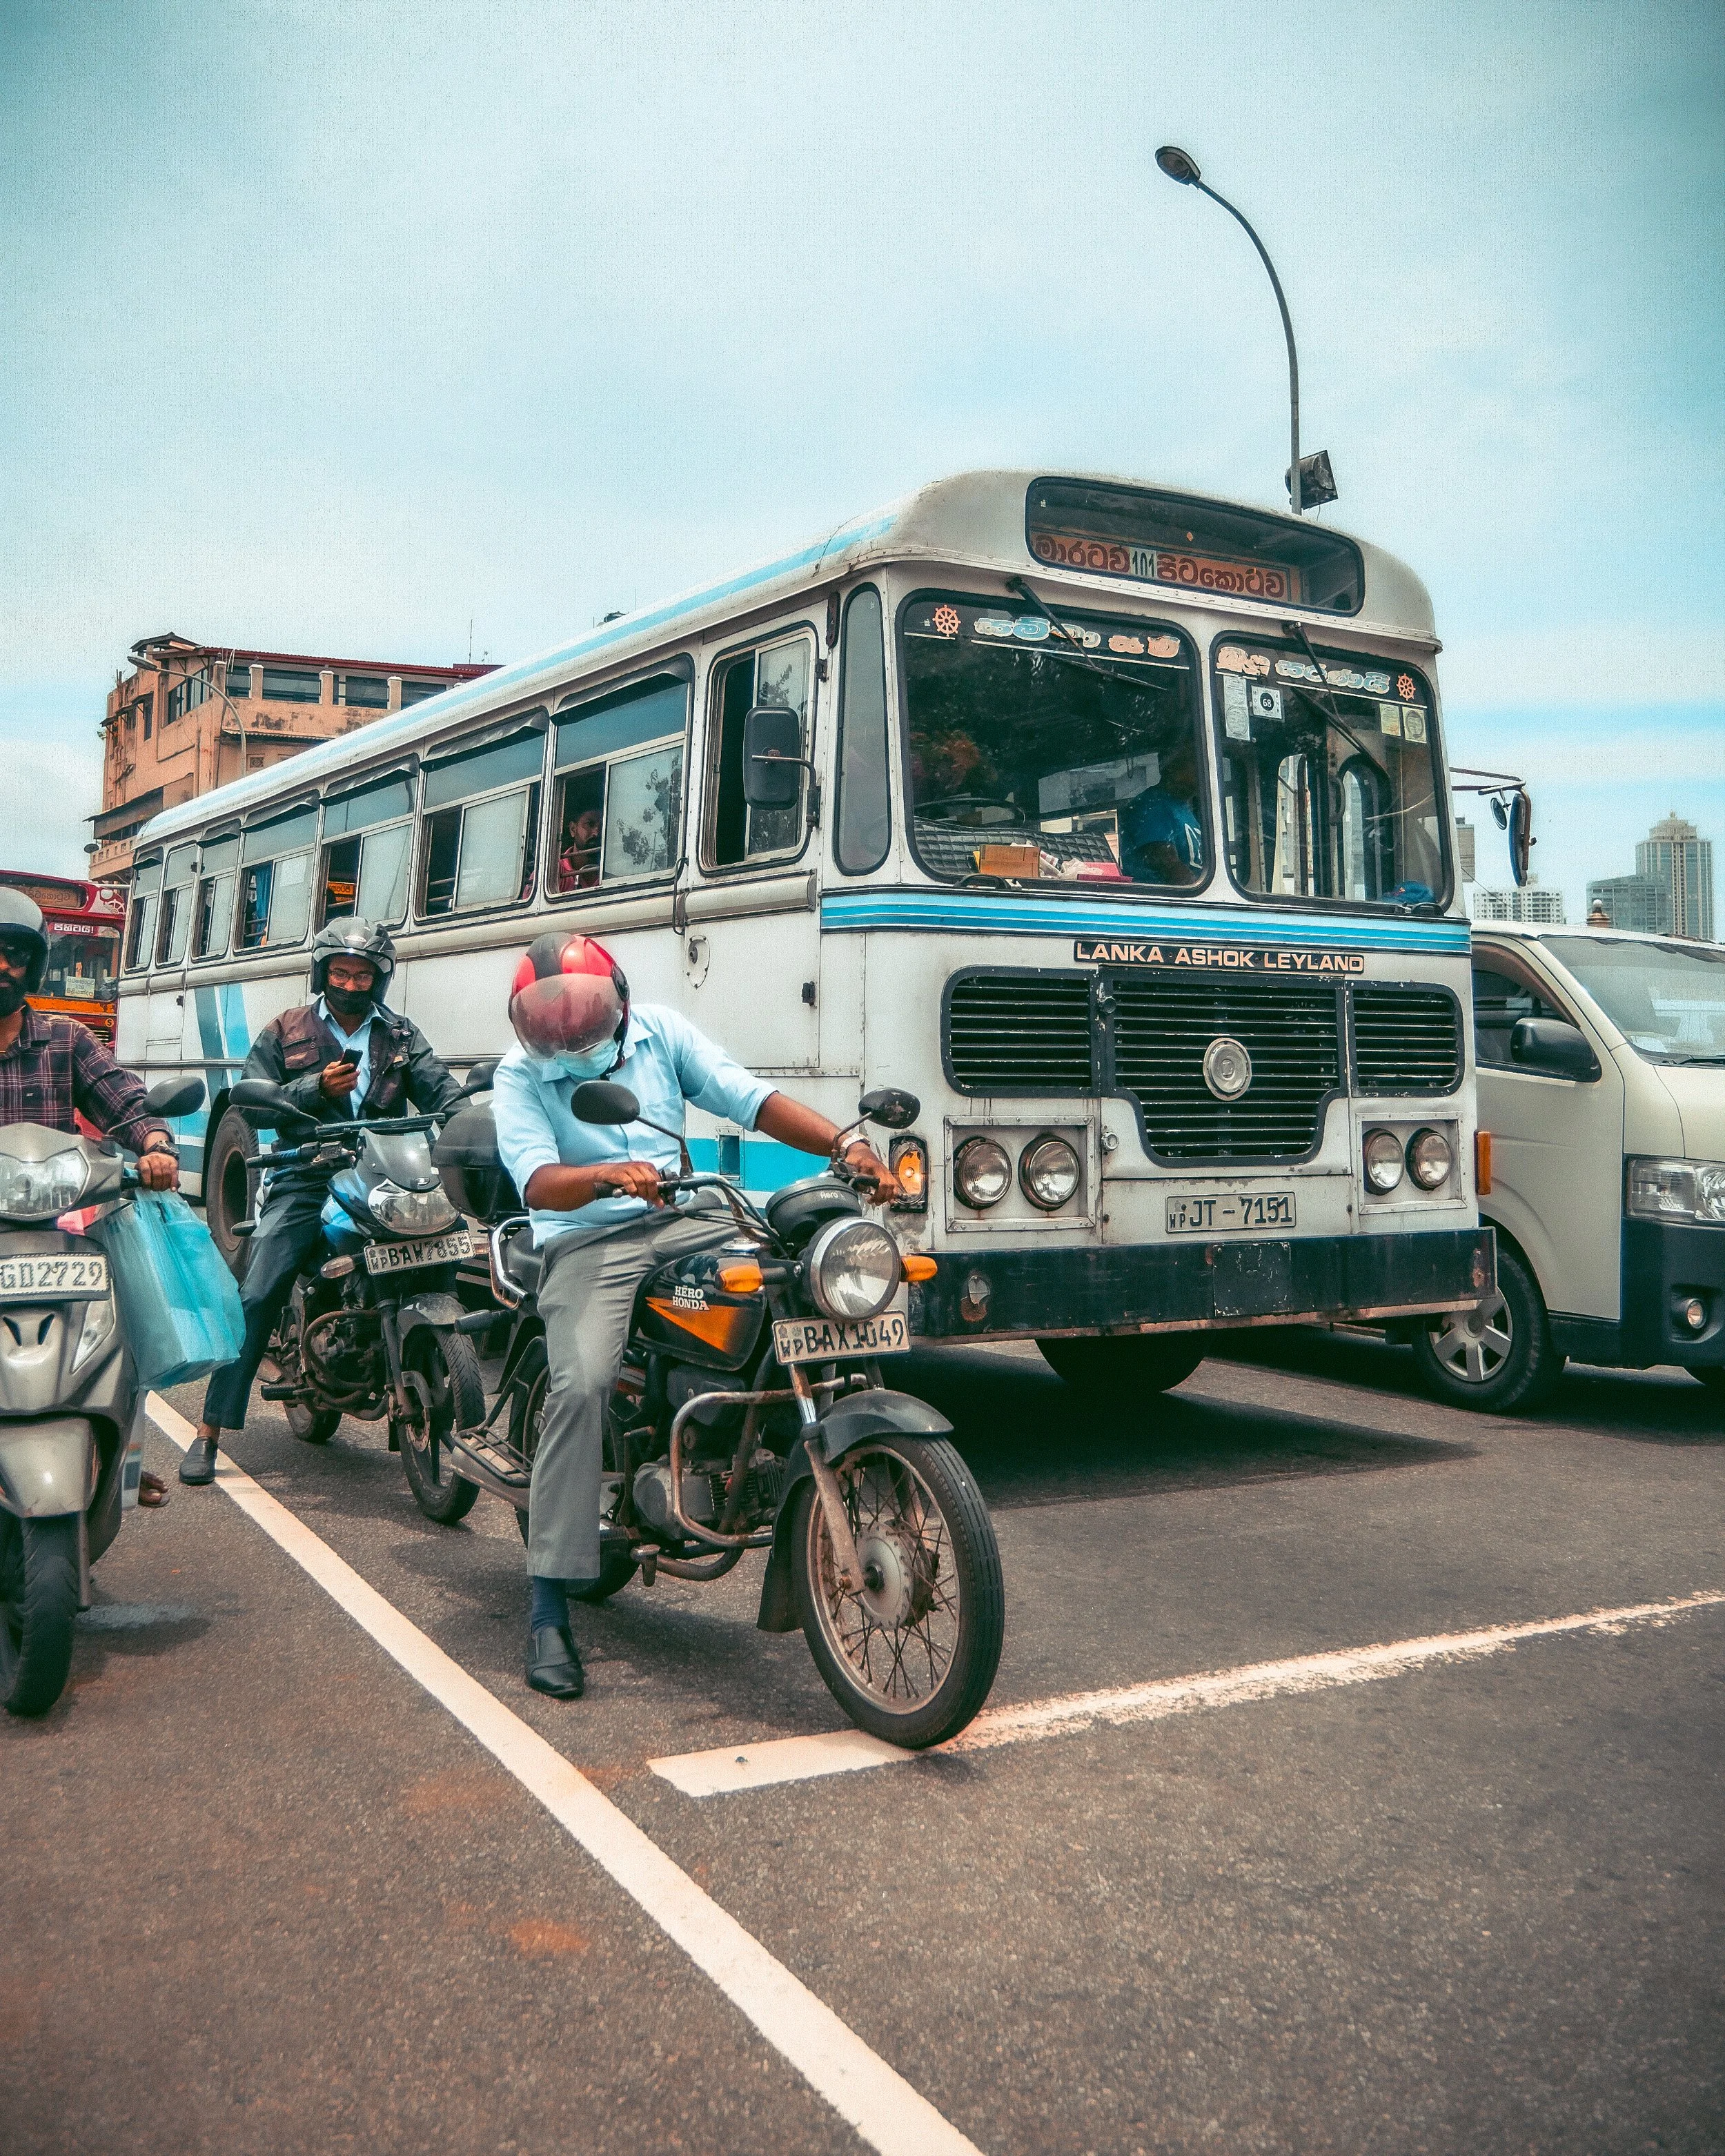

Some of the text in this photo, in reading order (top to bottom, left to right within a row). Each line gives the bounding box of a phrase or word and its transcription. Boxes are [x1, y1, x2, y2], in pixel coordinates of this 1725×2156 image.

[1132, 551, 1154, 577] 101
[1263, 698, 1272, 708] 68
[1076, 942, 1363, 971] LANKA ASHOK LEYLAND
[672, 1296, 711, 1311] HONDA
[780, 1338, 804, 1358] WP
